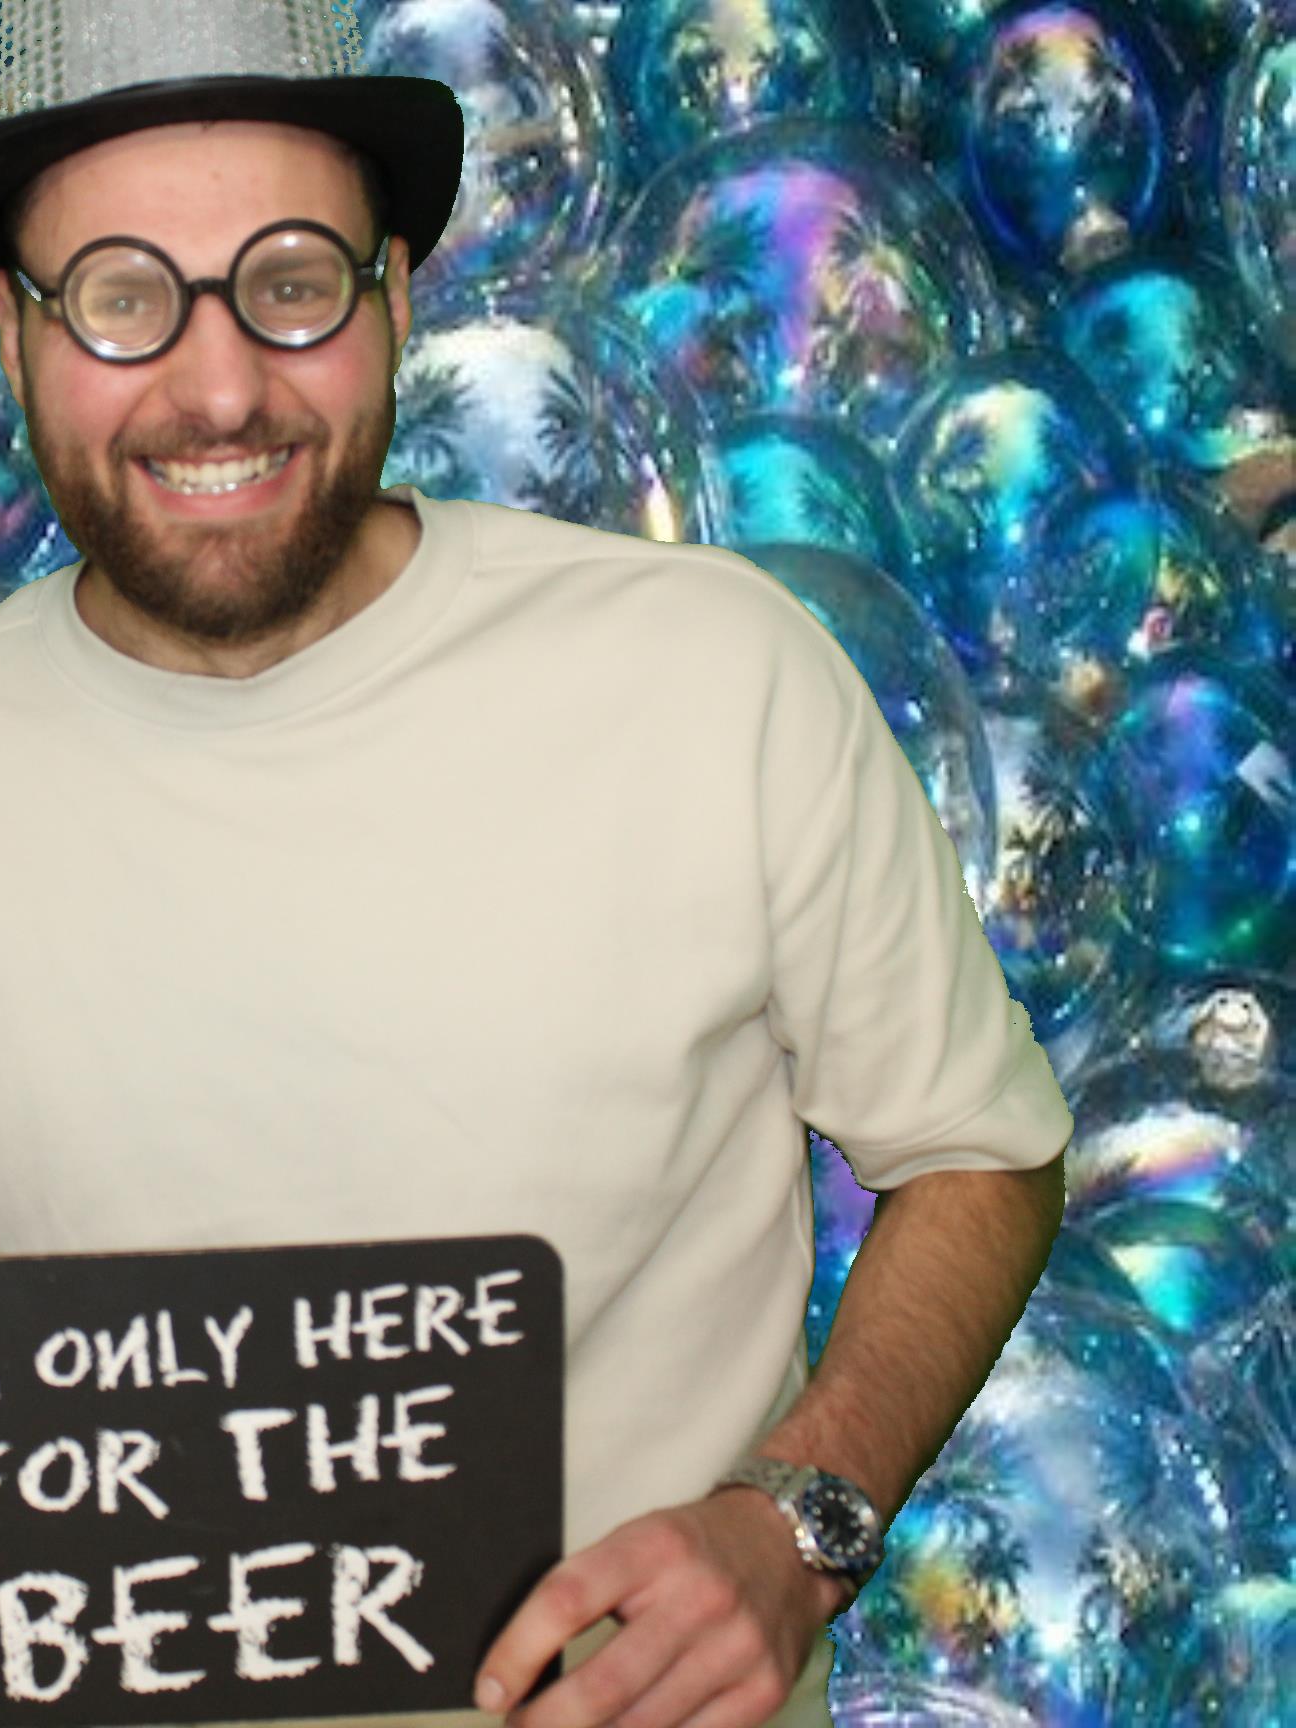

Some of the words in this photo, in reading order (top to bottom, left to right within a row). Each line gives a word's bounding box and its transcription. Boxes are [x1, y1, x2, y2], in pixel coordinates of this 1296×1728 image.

[34, 1306, 254, 1391] ONLY
[294, 1270, 524, 1369] HERE
[221, 1384, 456, 1501] THE
